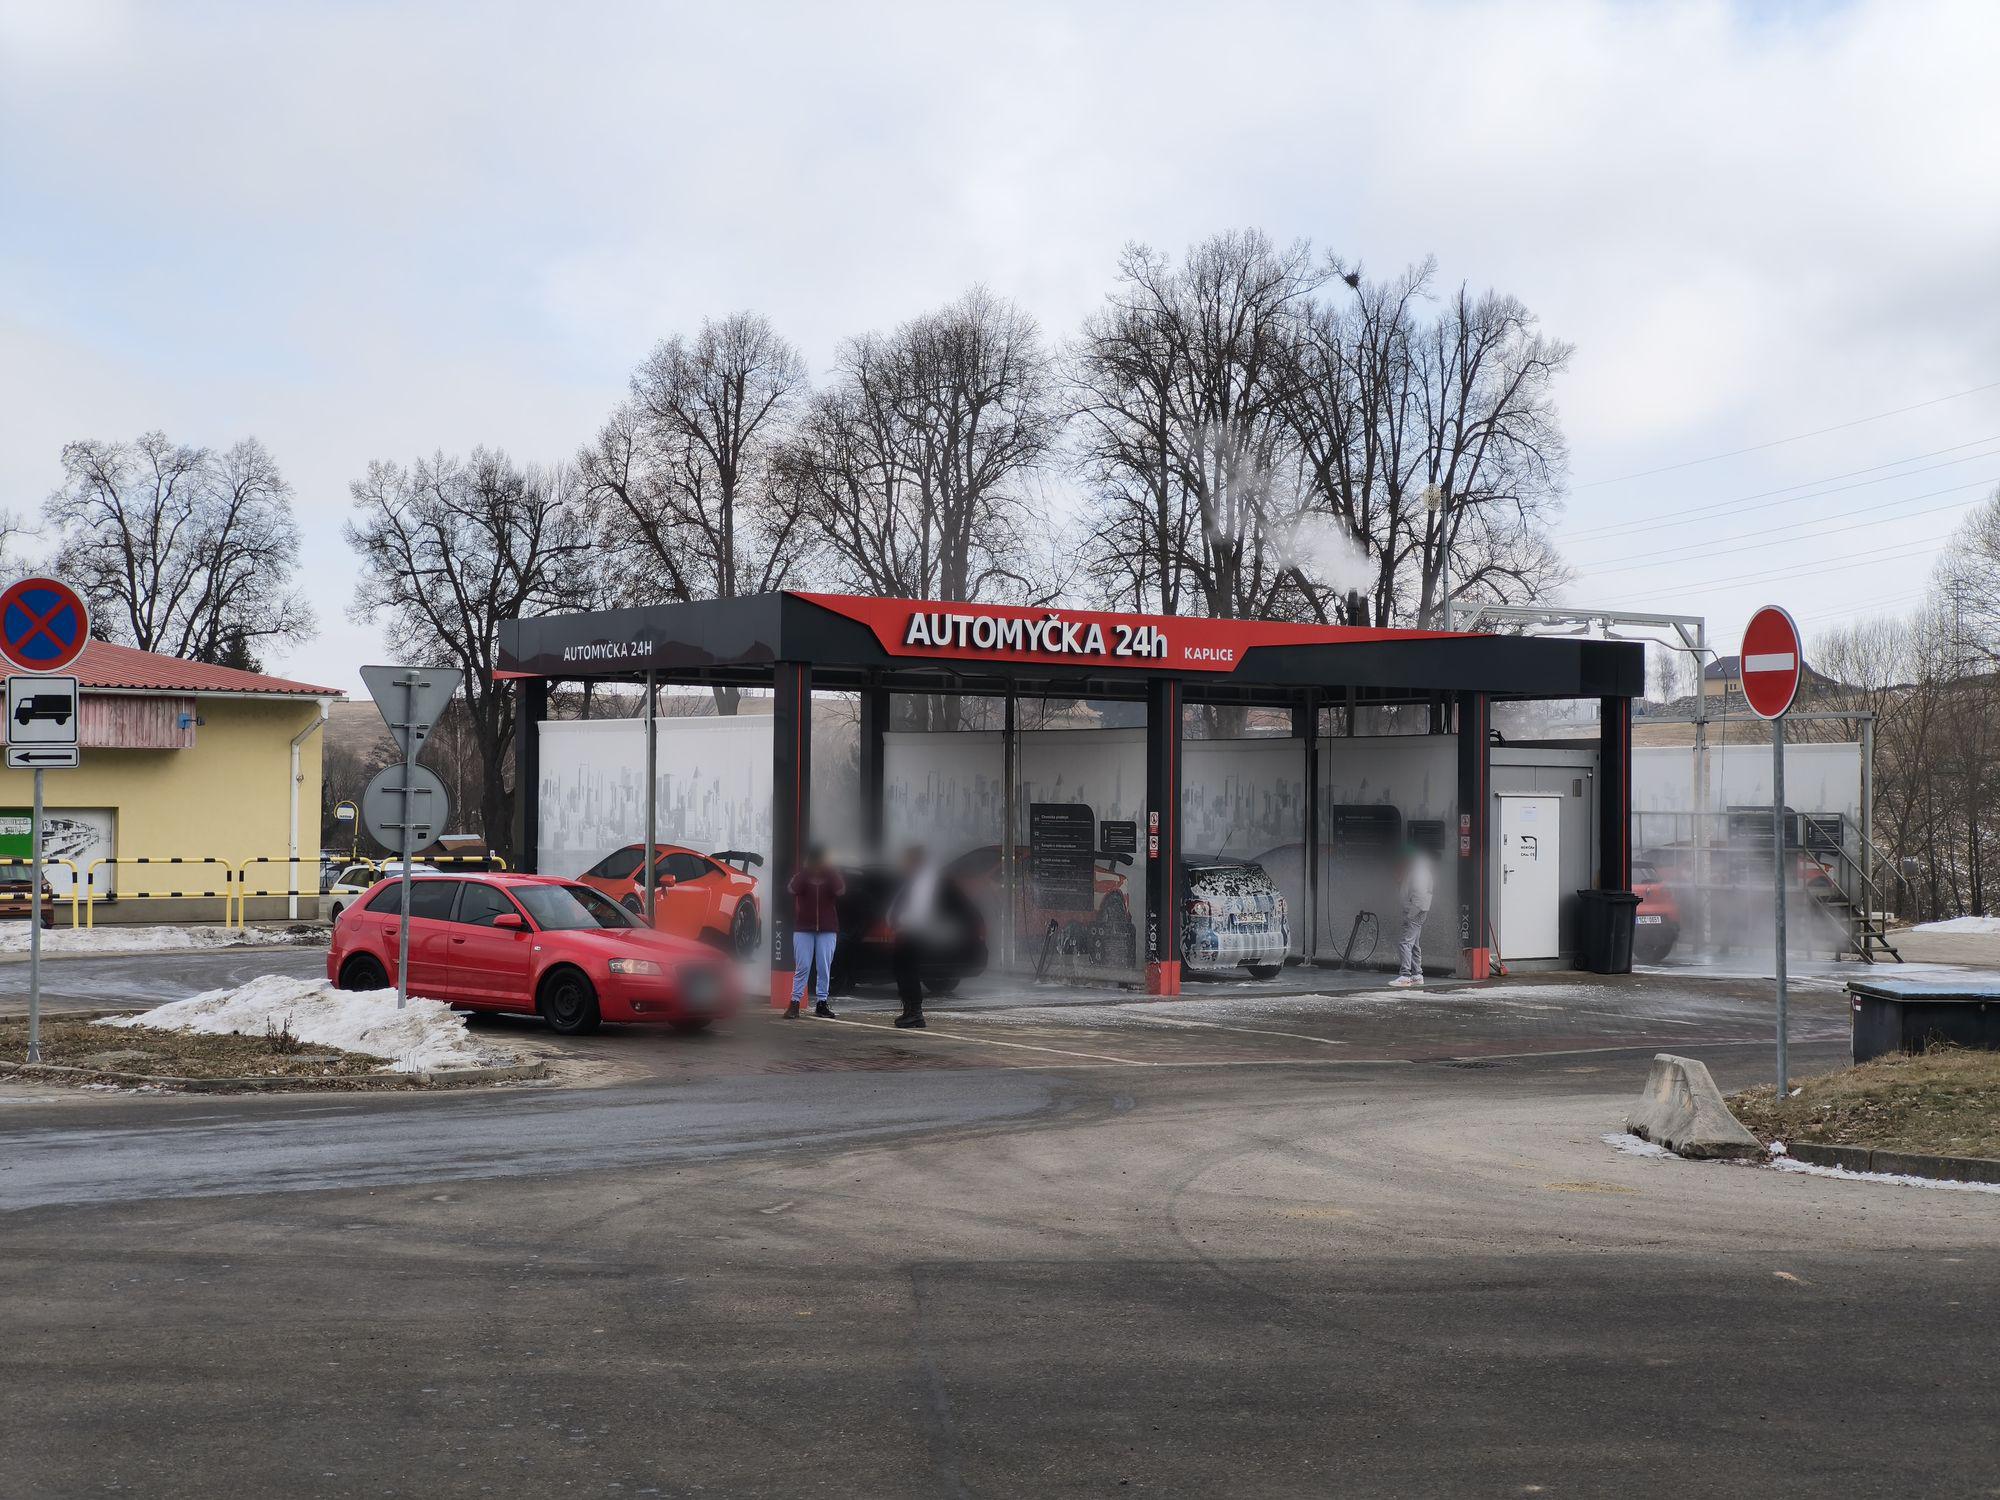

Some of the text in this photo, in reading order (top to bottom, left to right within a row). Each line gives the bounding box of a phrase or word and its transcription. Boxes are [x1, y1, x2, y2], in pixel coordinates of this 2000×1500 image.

[906, 612, 1168, 658] AUTOMYČKA 24h
[563, 640, 652, 661] AUTOMYČKA 24H
[1184, 647, 1234, 662] KAPLICE
